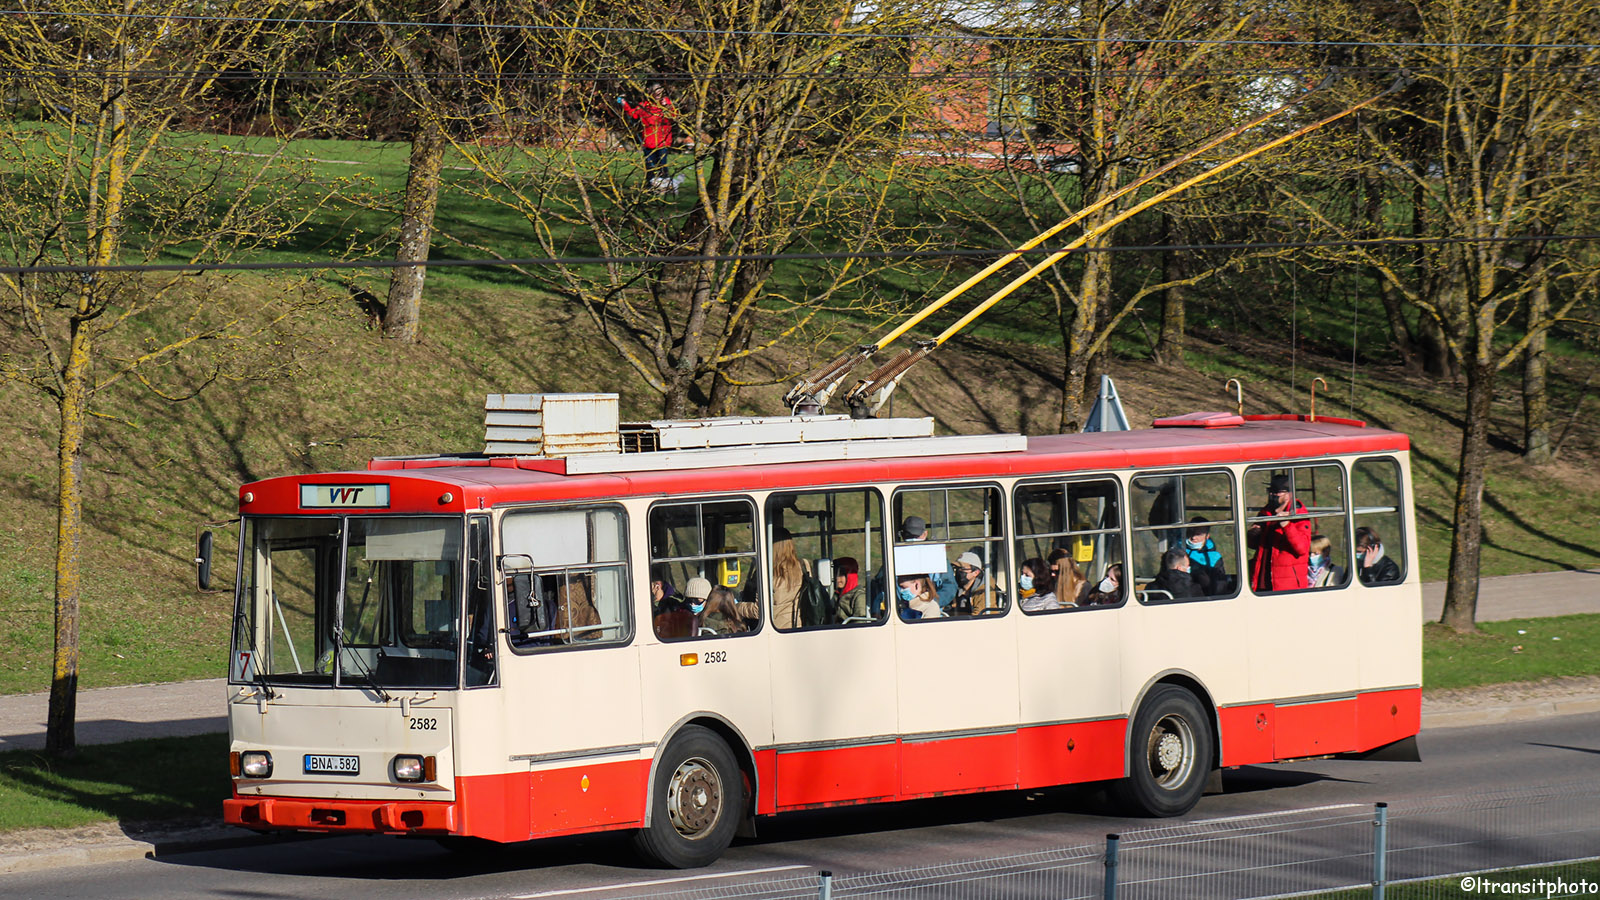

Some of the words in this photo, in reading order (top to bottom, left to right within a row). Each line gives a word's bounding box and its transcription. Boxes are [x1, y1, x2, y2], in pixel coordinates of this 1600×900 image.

[329, 487, 364, 504] VVT
[704, 650, 727, 664] 2582
[240, 652, 251, 679] 7
[409, 717, 437, 730] 2582
